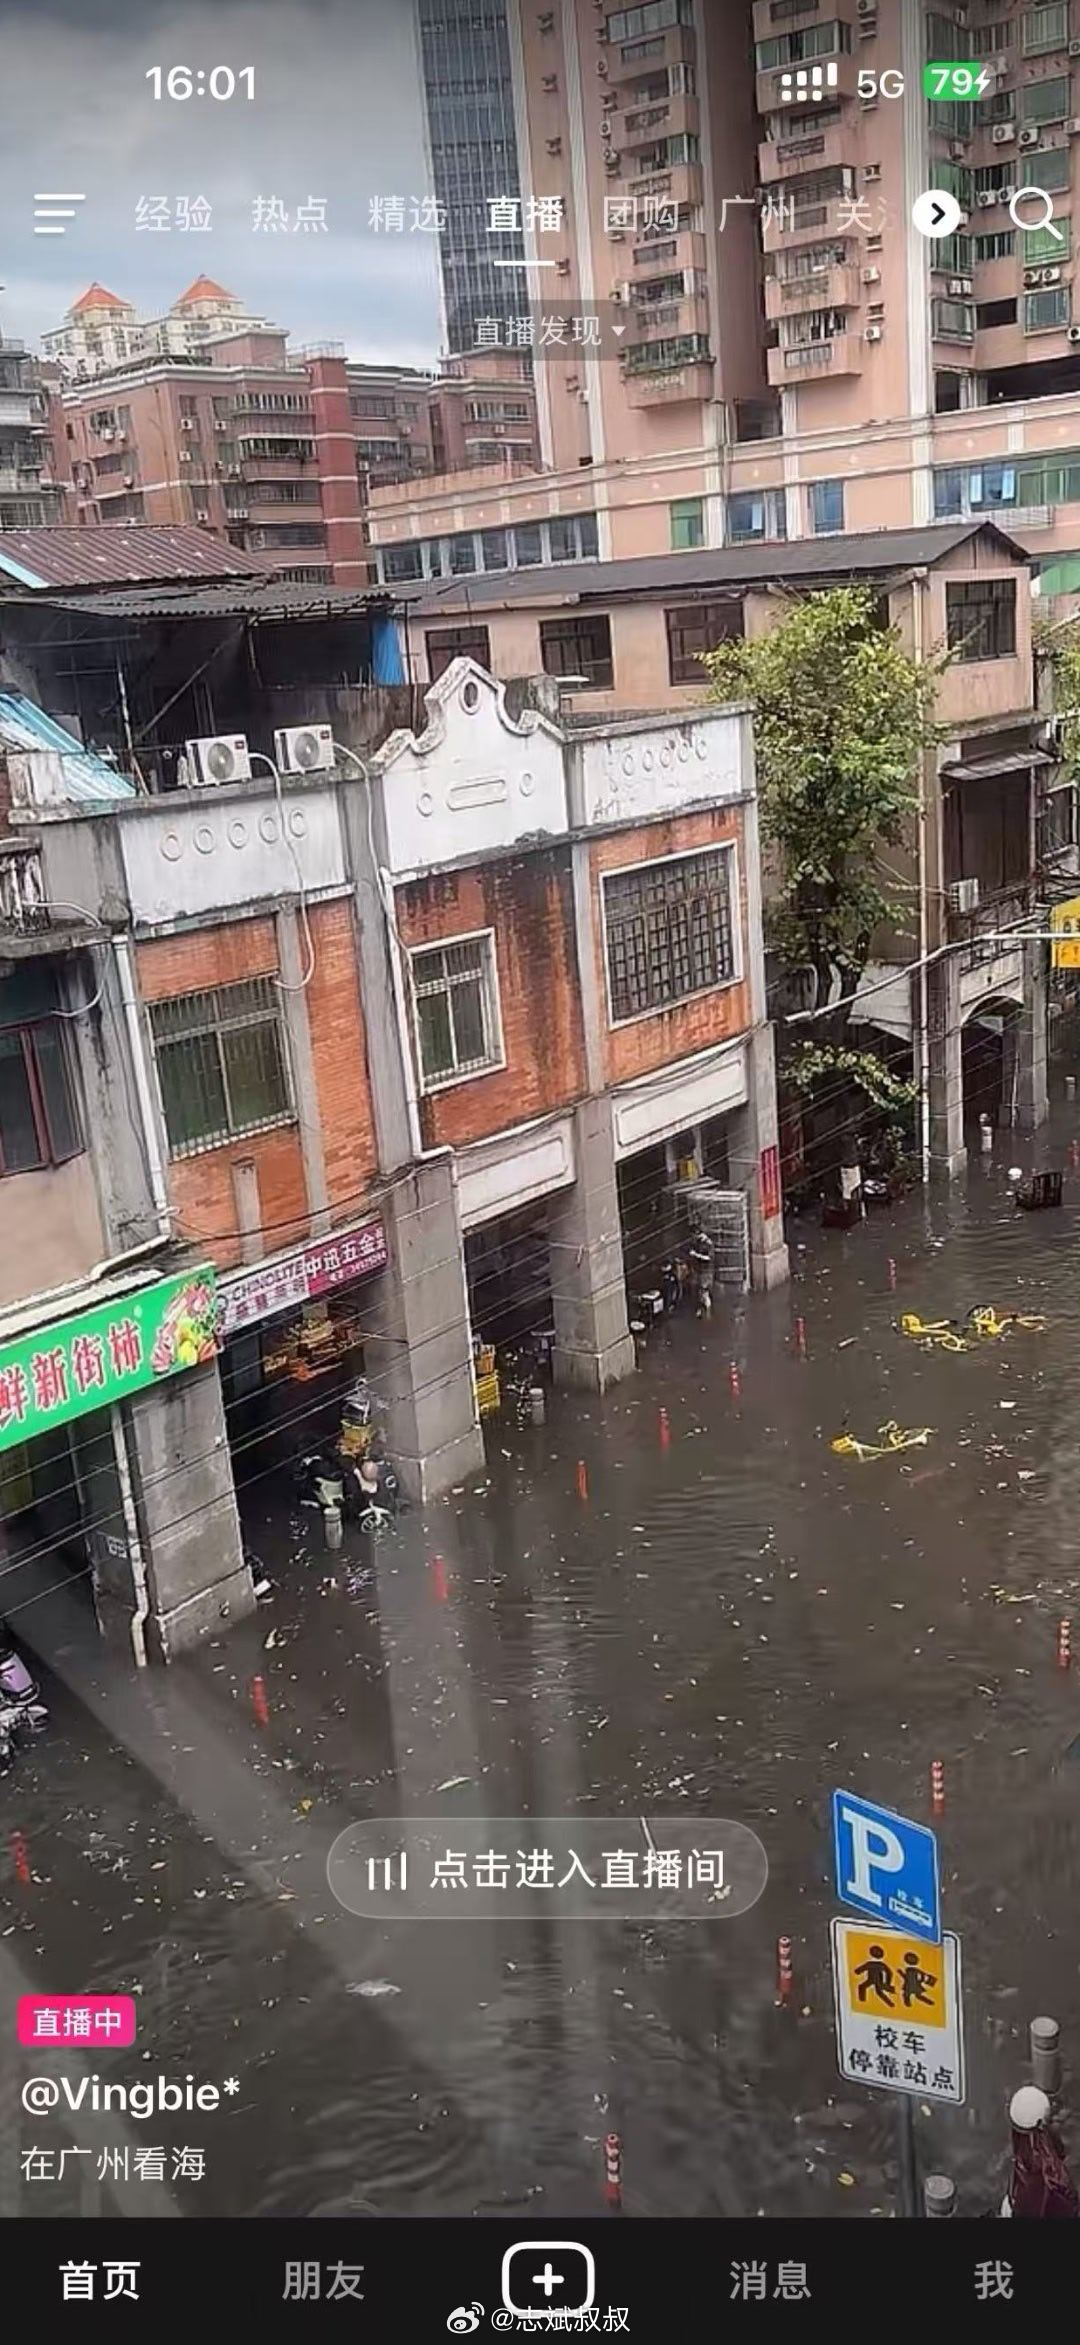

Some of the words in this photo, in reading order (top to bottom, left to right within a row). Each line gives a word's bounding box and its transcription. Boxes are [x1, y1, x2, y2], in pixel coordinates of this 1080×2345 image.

[843, 1807, 905, 1907] P
[873, 2025, 927, 2054] 校车
[849, 2049, 955, 2091] 停靠站点
